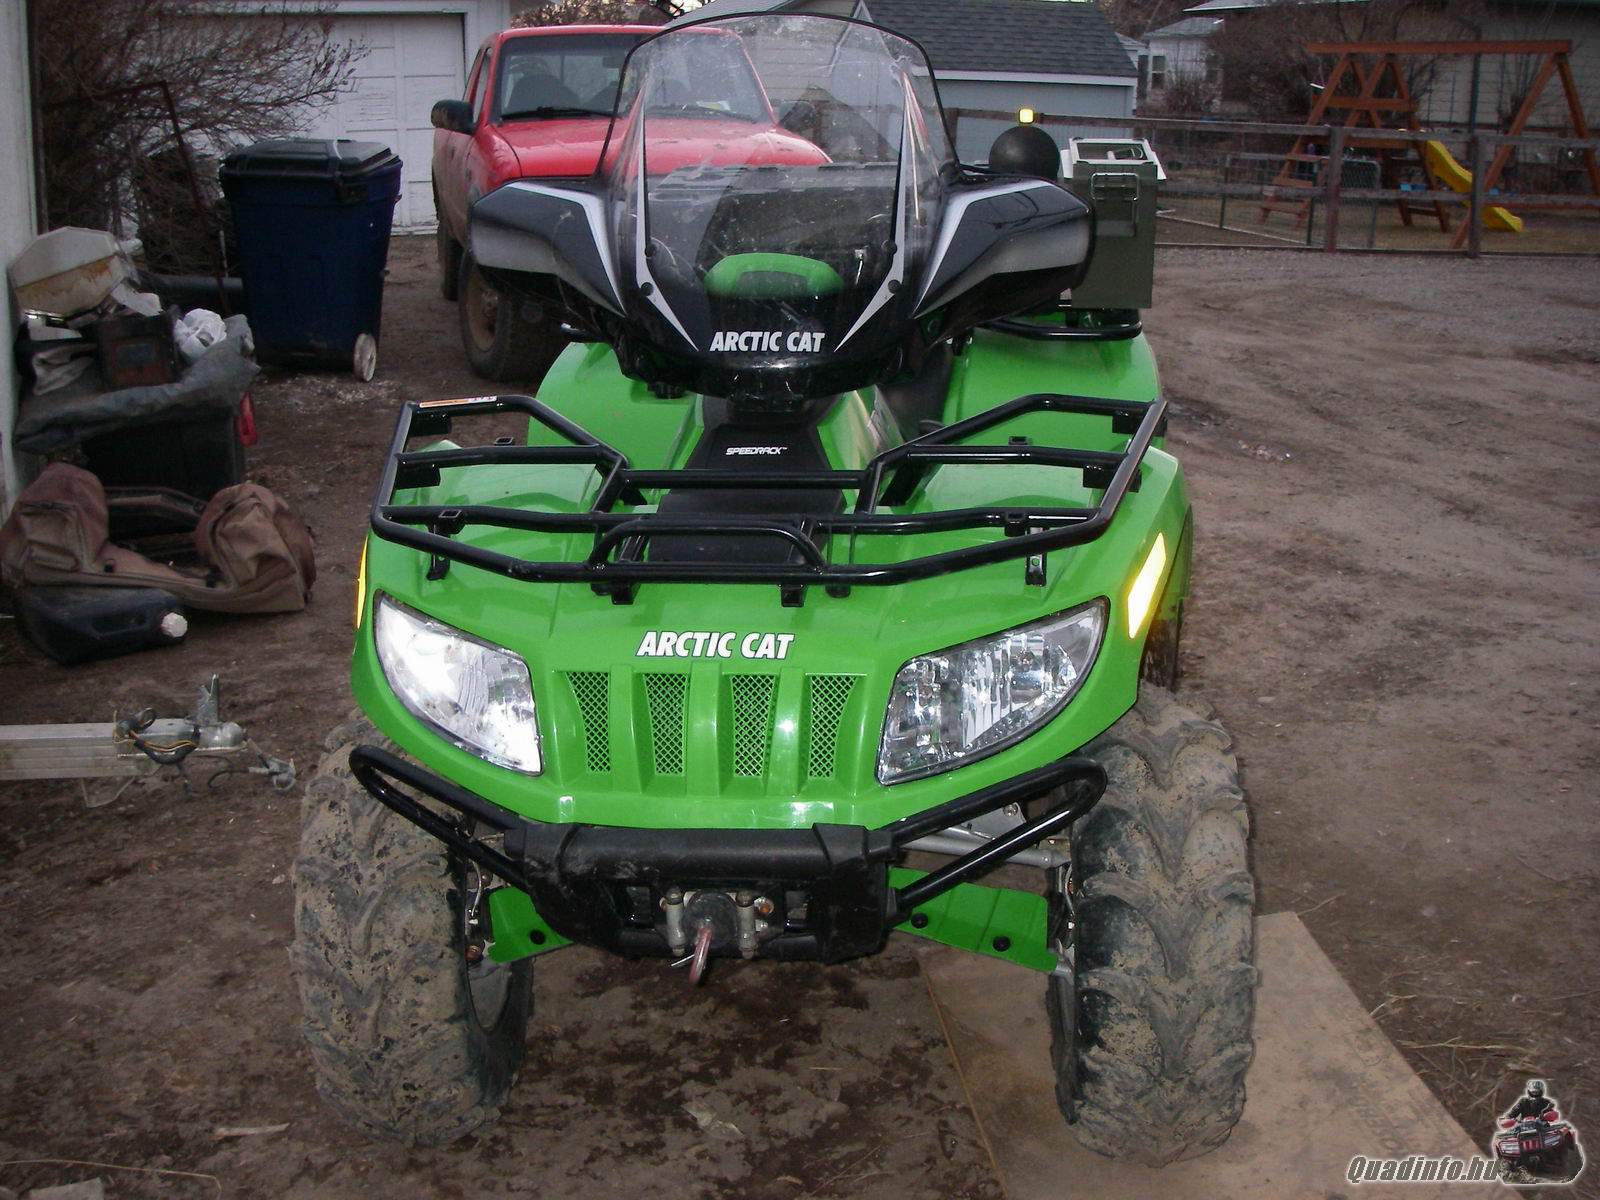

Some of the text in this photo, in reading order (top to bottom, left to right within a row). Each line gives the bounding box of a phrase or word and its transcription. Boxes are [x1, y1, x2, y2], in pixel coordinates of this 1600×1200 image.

[709, 331, 826, 353] ARCTIC CAT
[635, 630, 795, 660] ARCTIC CAT
